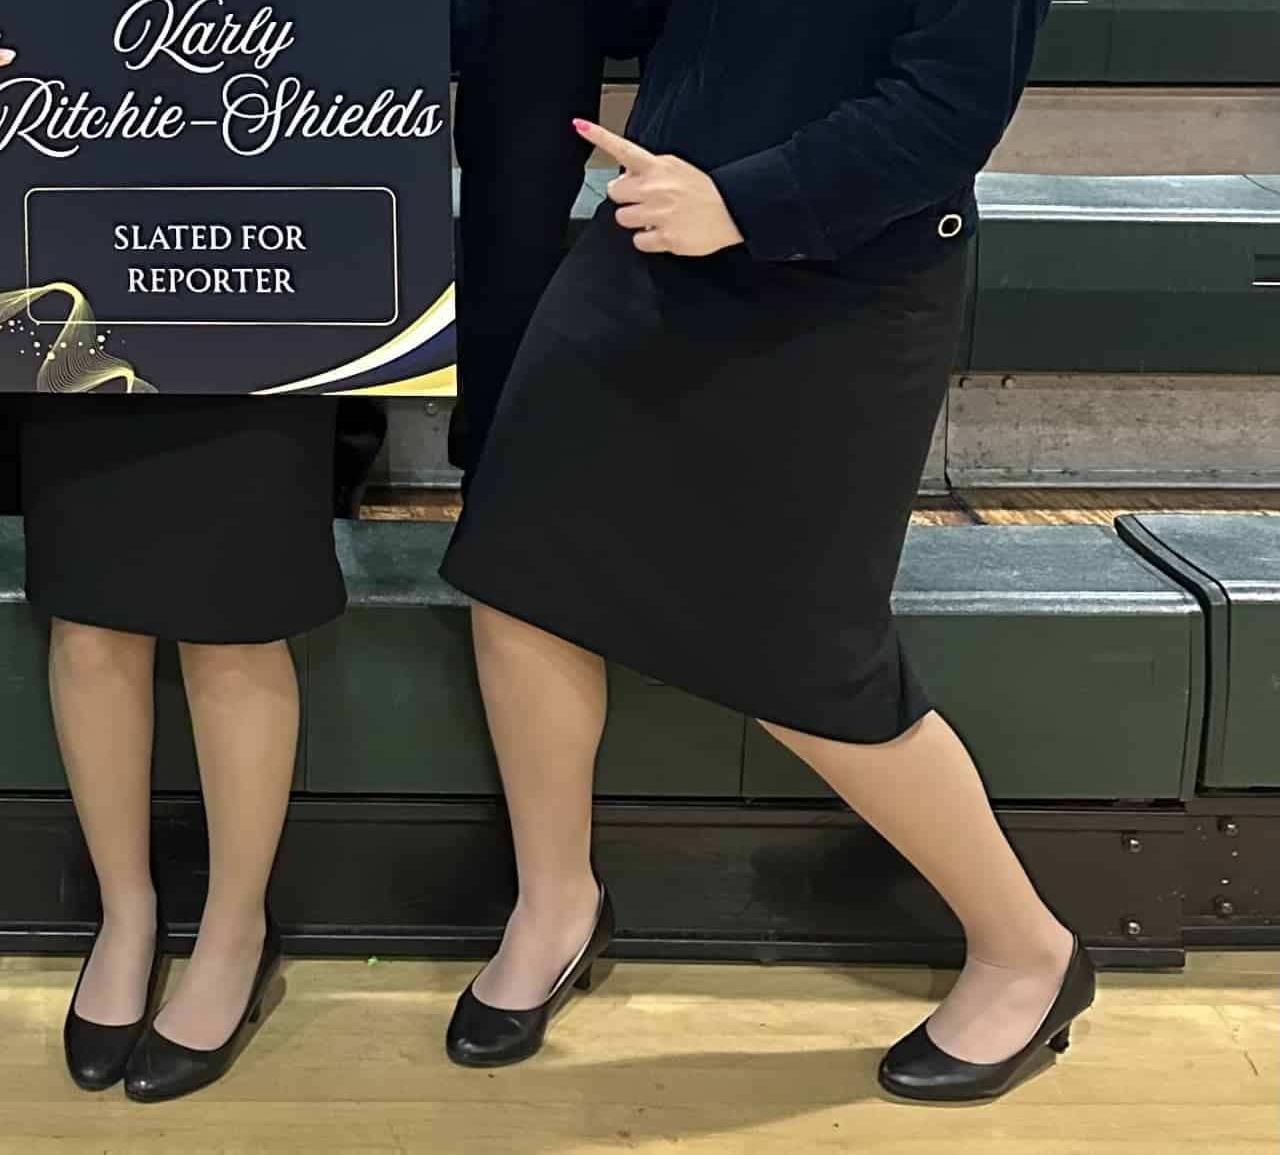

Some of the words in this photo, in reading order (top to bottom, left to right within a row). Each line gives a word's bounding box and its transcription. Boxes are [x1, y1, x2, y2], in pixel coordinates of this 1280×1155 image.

[114, 225, 232, 251] SLATED
[242, 225, 307, 251] FOR
[127, 268, 296, 294] REPORTER
